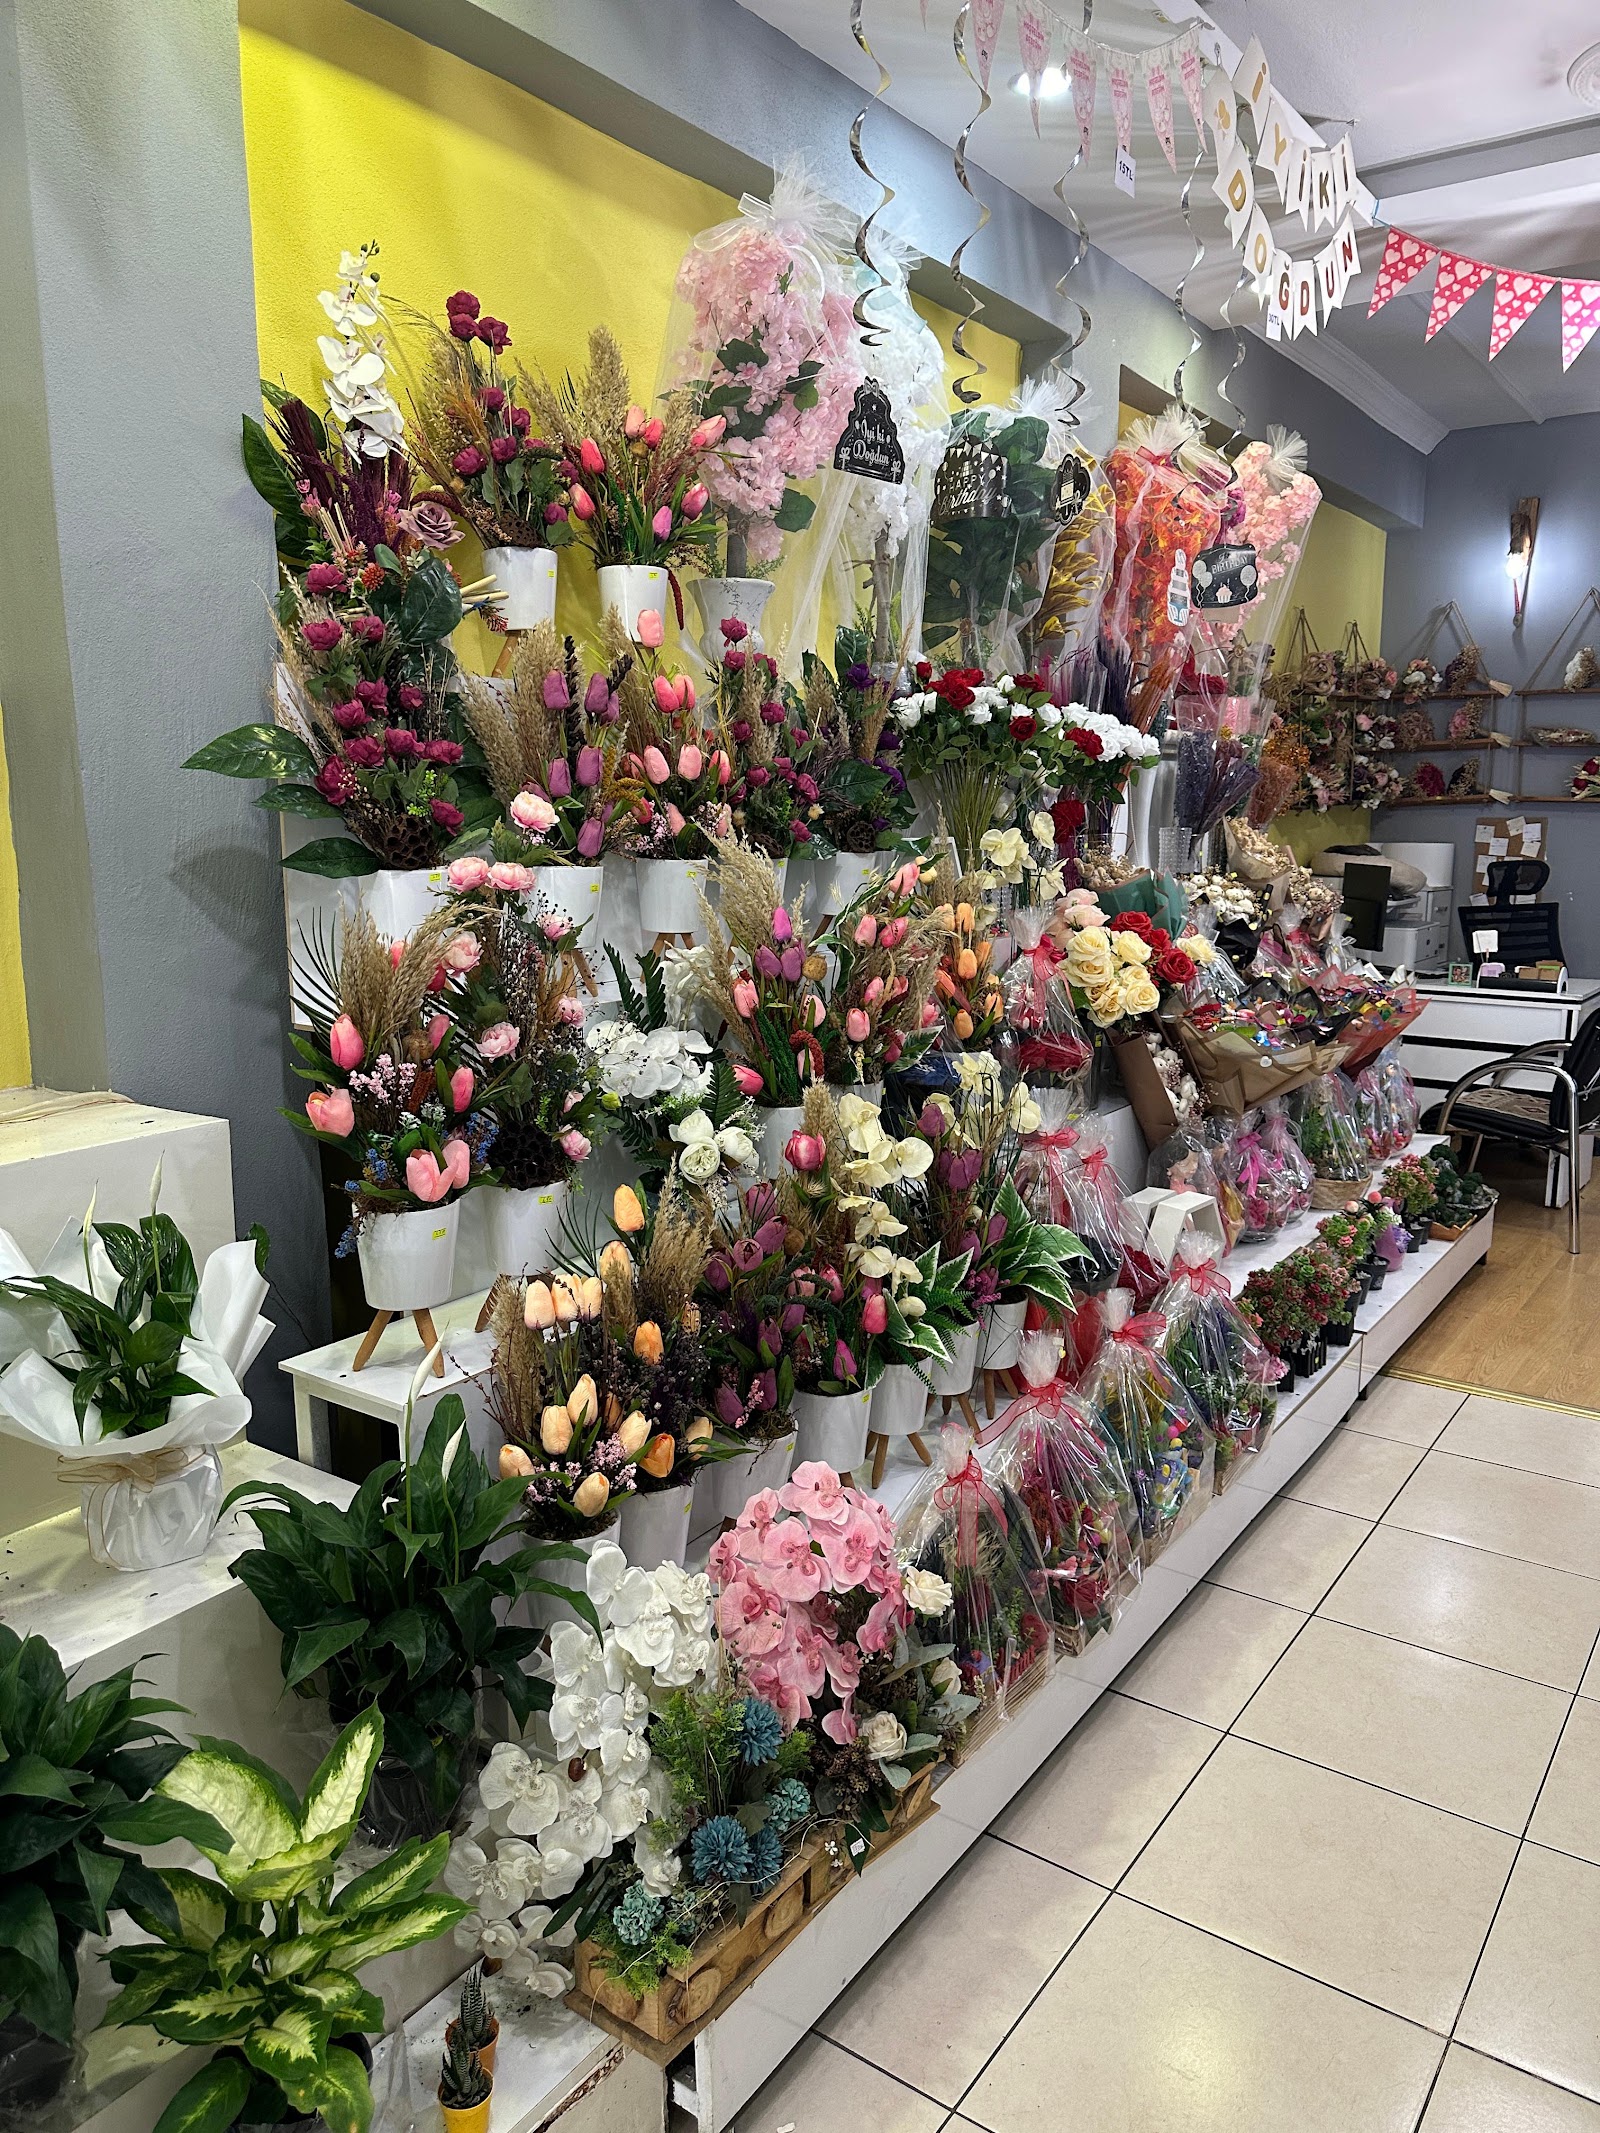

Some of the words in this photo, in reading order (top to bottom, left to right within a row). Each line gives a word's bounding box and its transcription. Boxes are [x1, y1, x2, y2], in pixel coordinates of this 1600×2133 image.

[1119, 160, 1133, 181] 15TL
[1228, 168, 1353, 316] DOĞDUN
[853, 439, 890, 467] Doğdun
[1211, 555, 1248, 574] BIRTHDAY
